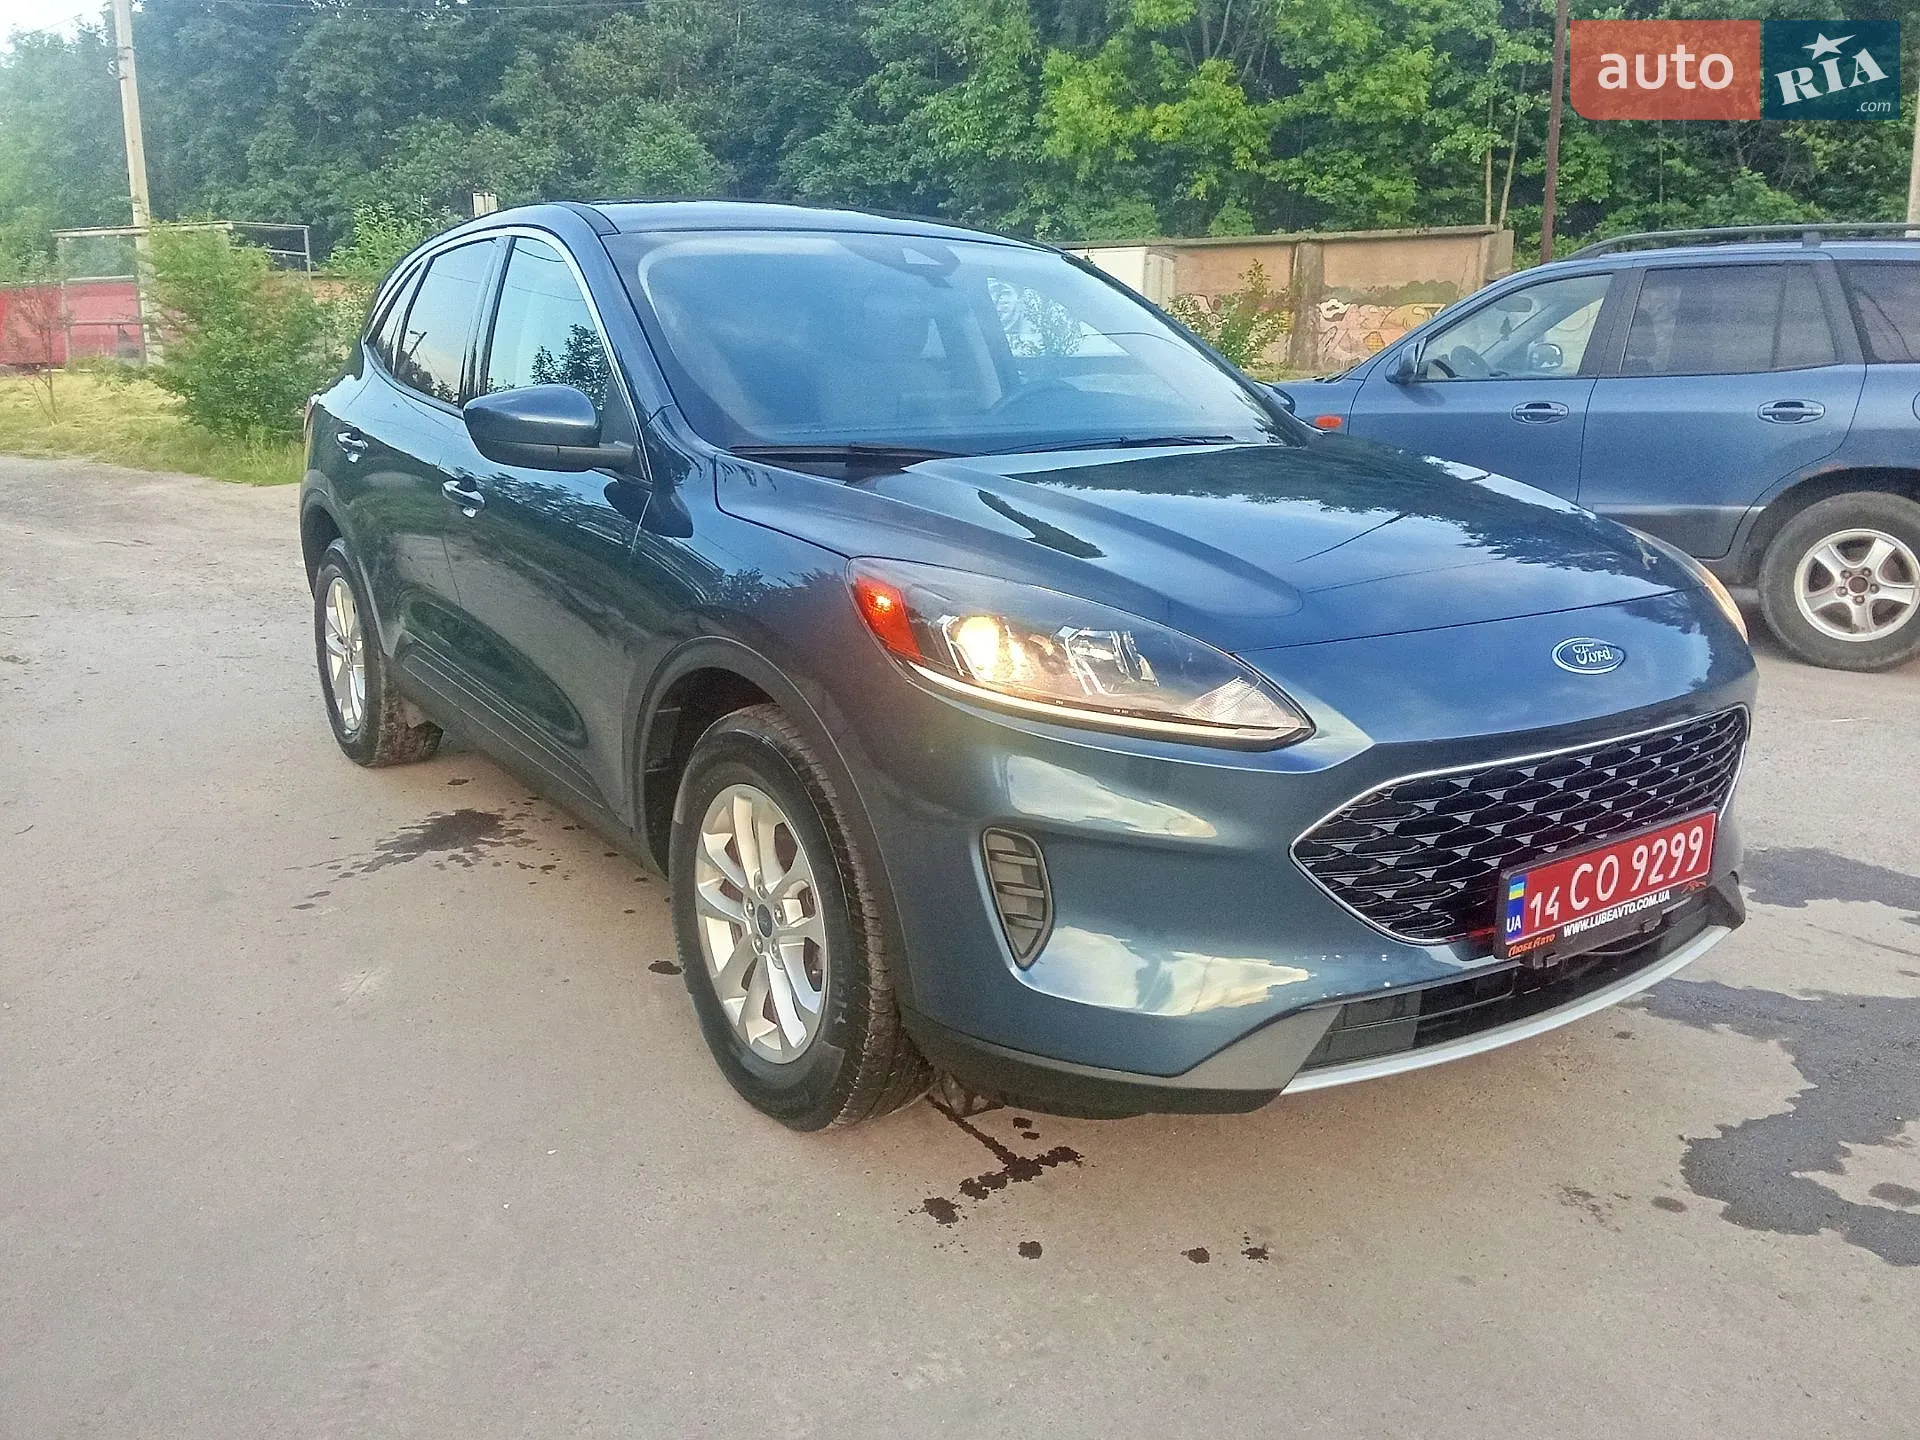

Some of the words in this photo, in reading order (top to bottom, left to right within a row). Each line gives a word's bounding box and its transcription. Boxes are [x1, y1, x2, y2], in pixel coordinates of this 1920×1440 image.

[1573, 643, 1613, 664] Ford
[1529, 885, 1560, 928] 14
[1569, 854, 1619, 911] CO
[1630, 826, 1704, 892] 9299
[1506, 914, 1522, 933] UA
[1563, 889, 1671, 938] WWW.LUBEAVTO.COM.UA
